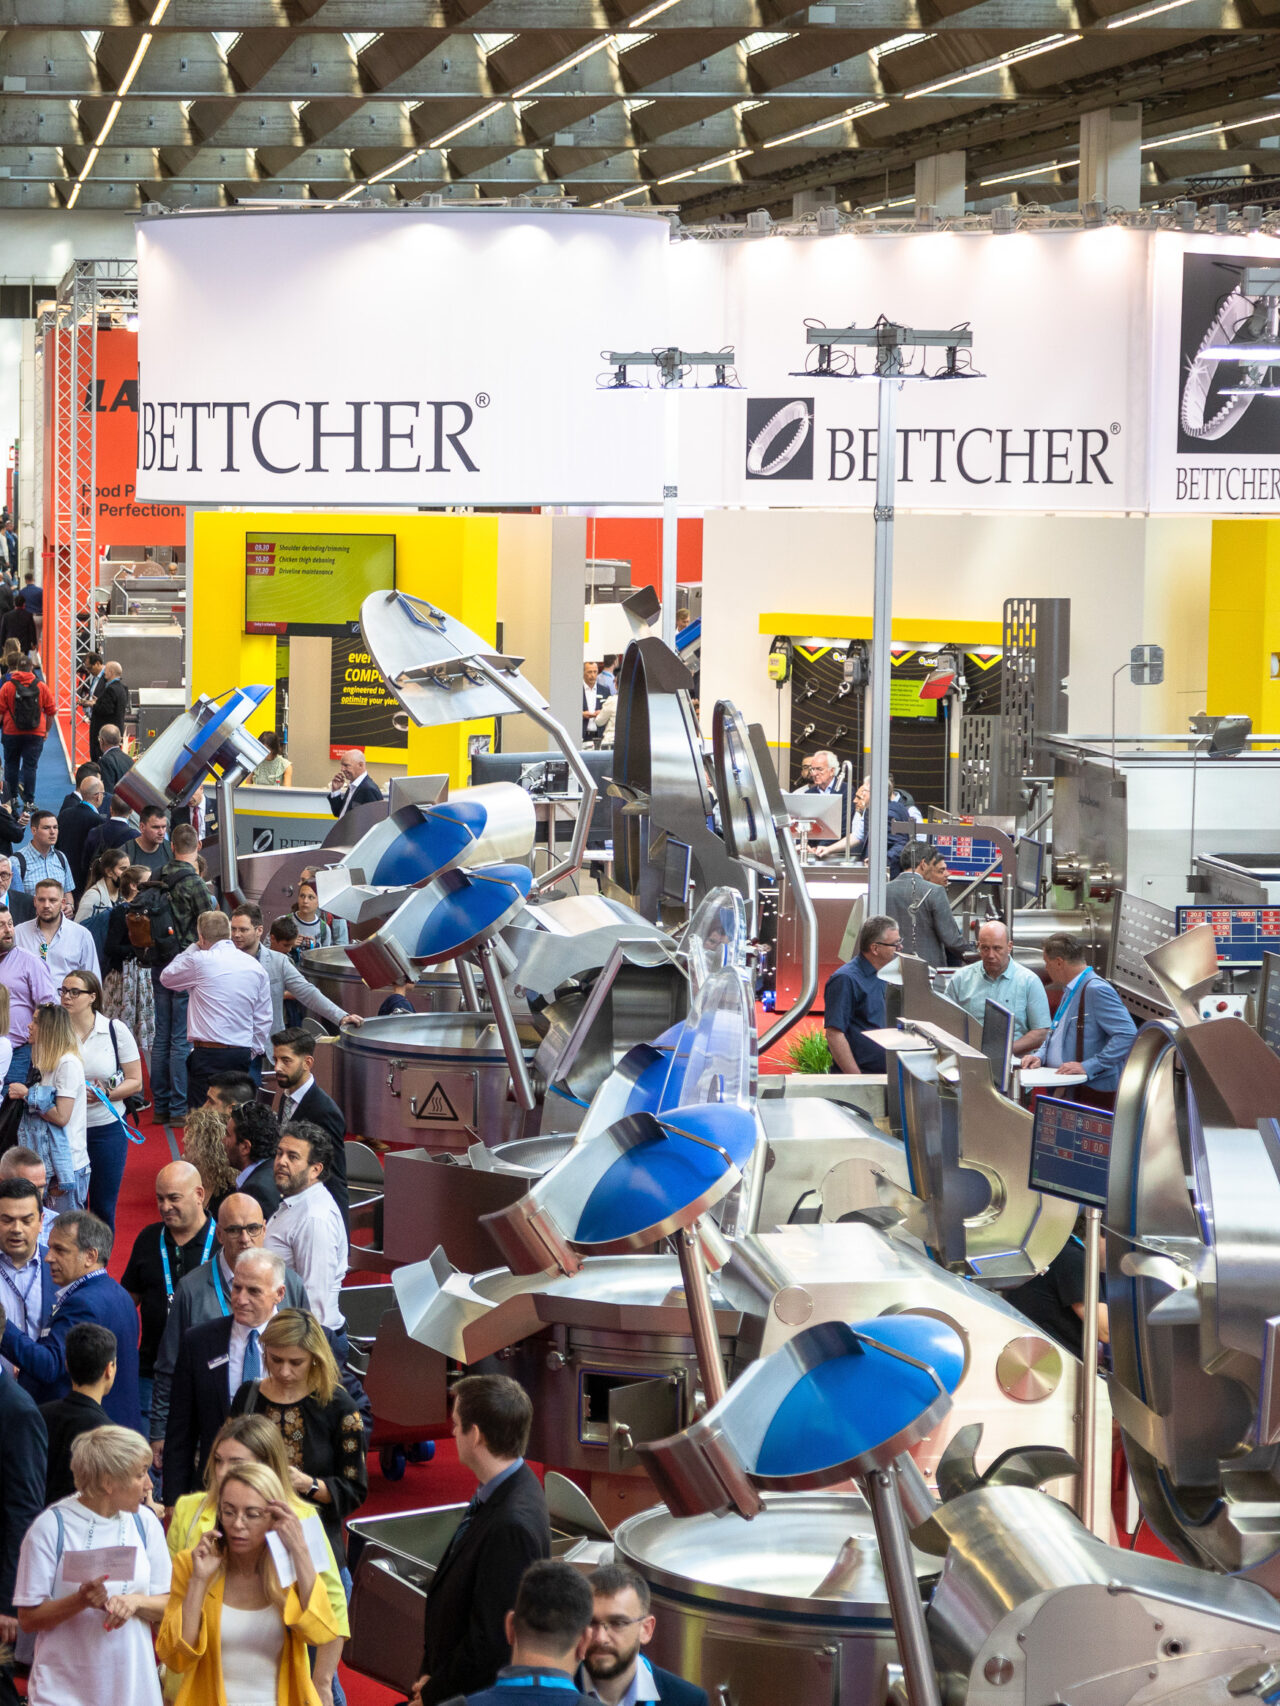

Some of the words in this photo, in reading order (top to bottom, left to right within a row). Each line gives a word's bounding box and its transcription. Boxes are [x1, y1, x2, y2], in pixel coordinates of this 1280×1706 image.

[82, 379, 139, 413] LA
[125, 485, 135, 497] P
[99, 503, 185, 517] Perfection.
[279, 555, 298, 563] Chicken
[299, 556, 311, 565] thigh
[279, 567, 301, 575] Driveline
[301, 568, 333, 576] maintenance
[348, 652, 376, 667] ever
[344, 667, 385, 683] COMP
[342, 686, 377, 696] engineered
[378, 686, 386, 695] to
[341, 696, 369, 705] optimize
[369, 697, 383, 706] your
